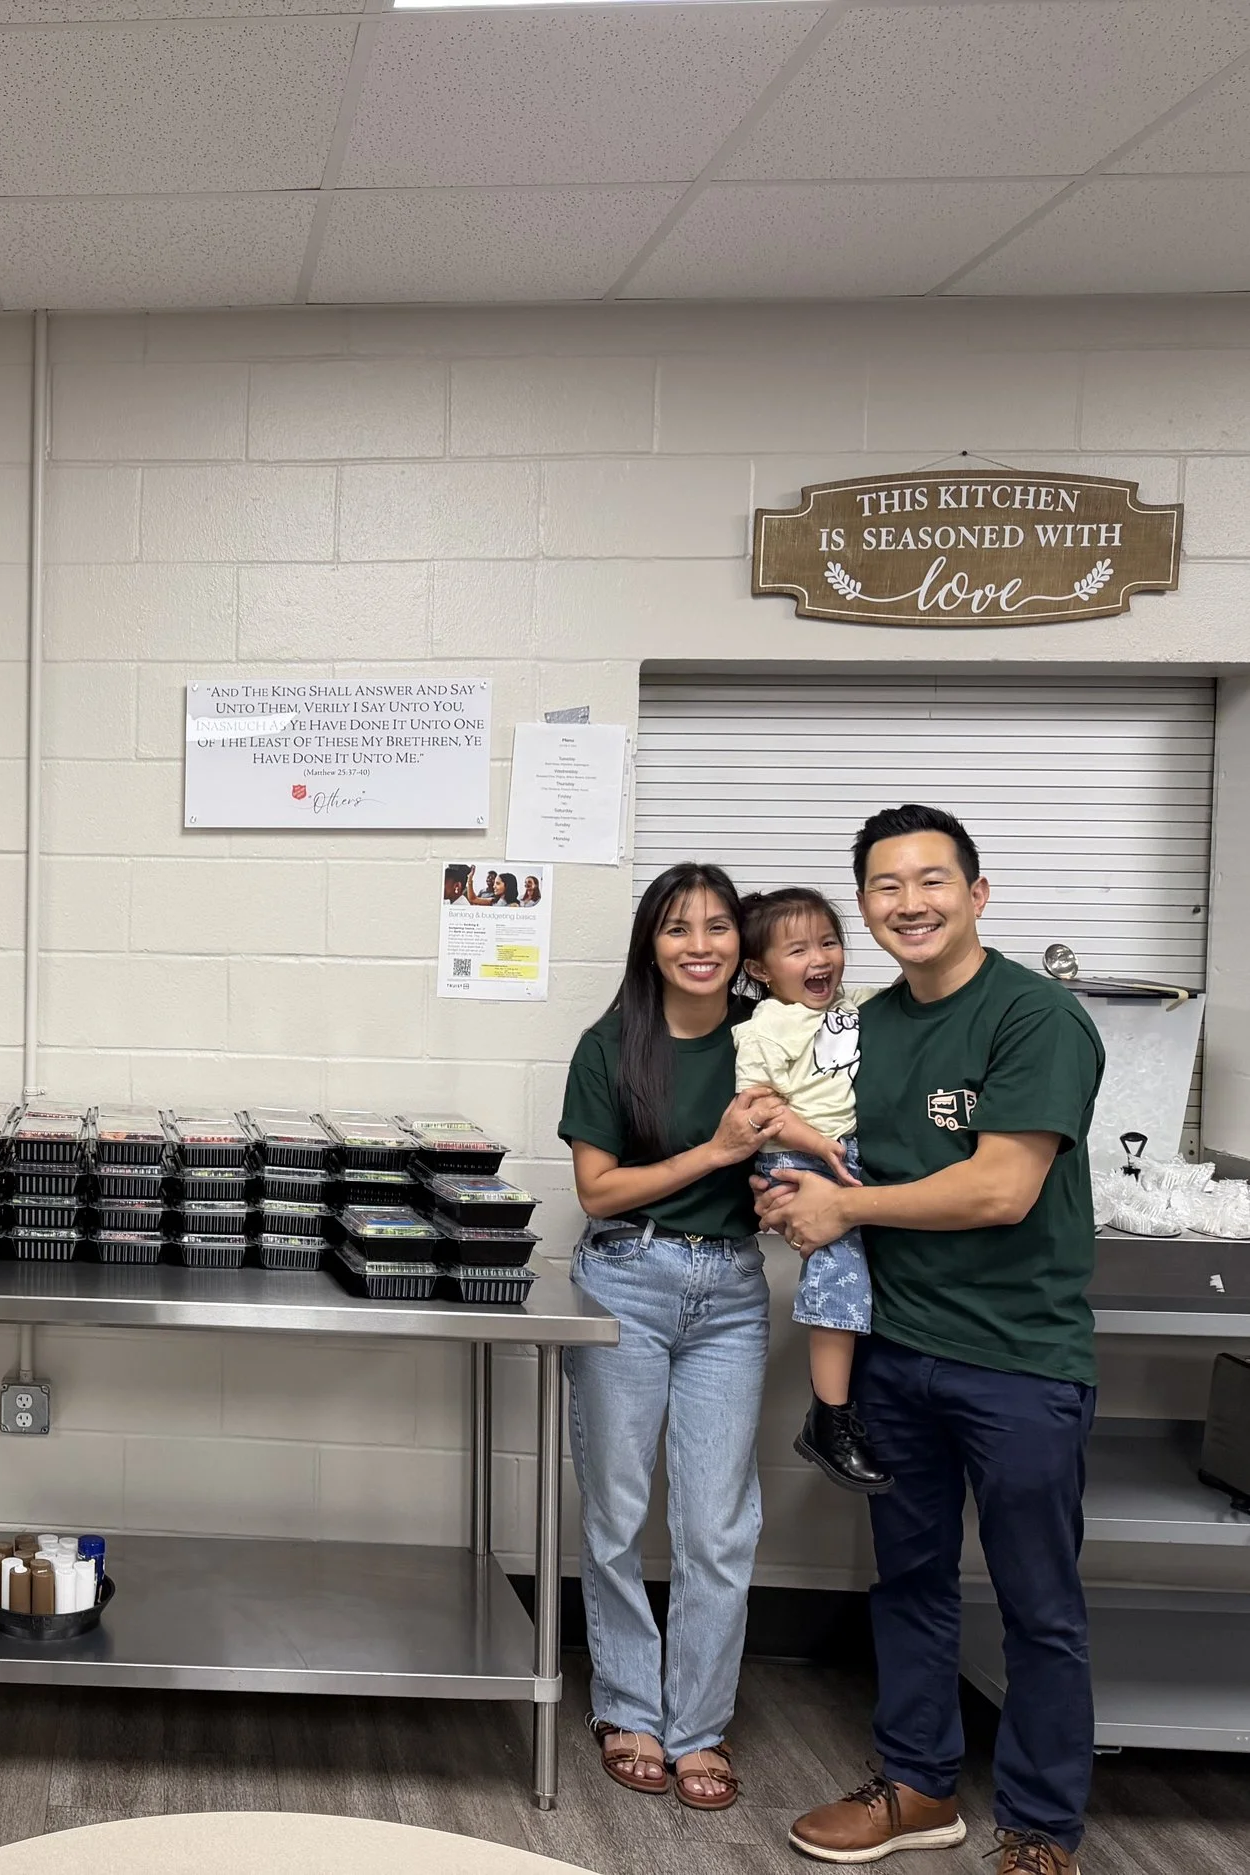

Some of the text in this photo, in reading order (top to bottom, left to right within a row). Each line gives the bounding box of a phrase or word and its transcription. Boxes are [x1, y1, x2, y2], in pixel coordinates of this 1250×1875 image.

[856, 485, 1081, 517] THIS KITCHEN
[818, 523, 1123, 552] IS SEASONED WITH
[914, 556, 1027, 613] love
[353, 702, 357, 712] I
[303, 769, 335, 777] (Matthew
[448, 911, 474, 919] Banking
[481, 912, 515, 921] budgeting
